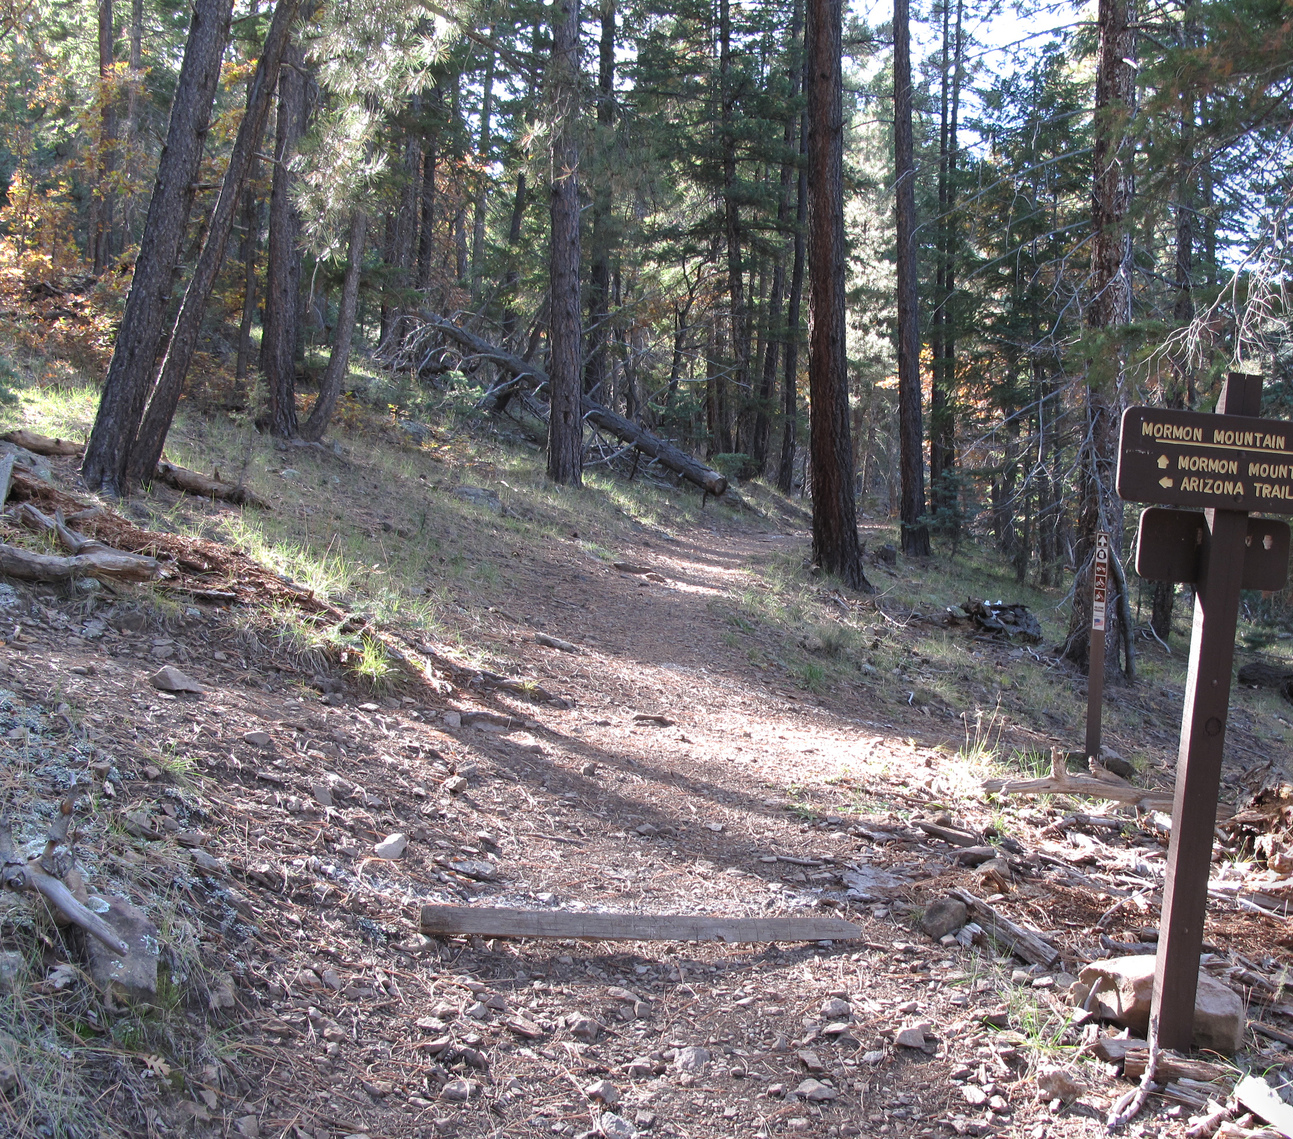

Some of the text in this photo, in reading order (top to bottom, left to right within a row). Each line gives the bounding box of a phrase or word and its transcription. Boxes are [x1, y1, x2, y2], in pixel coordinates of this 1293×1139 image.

[1142, 422, 1202, 441] MORMON
[1213, 430, 1285, 449] MOUNTAIN
[1178, 455, 1238, 474] MORMON
[1180, 477, 1293, 499] ARIZONA TRAIL
